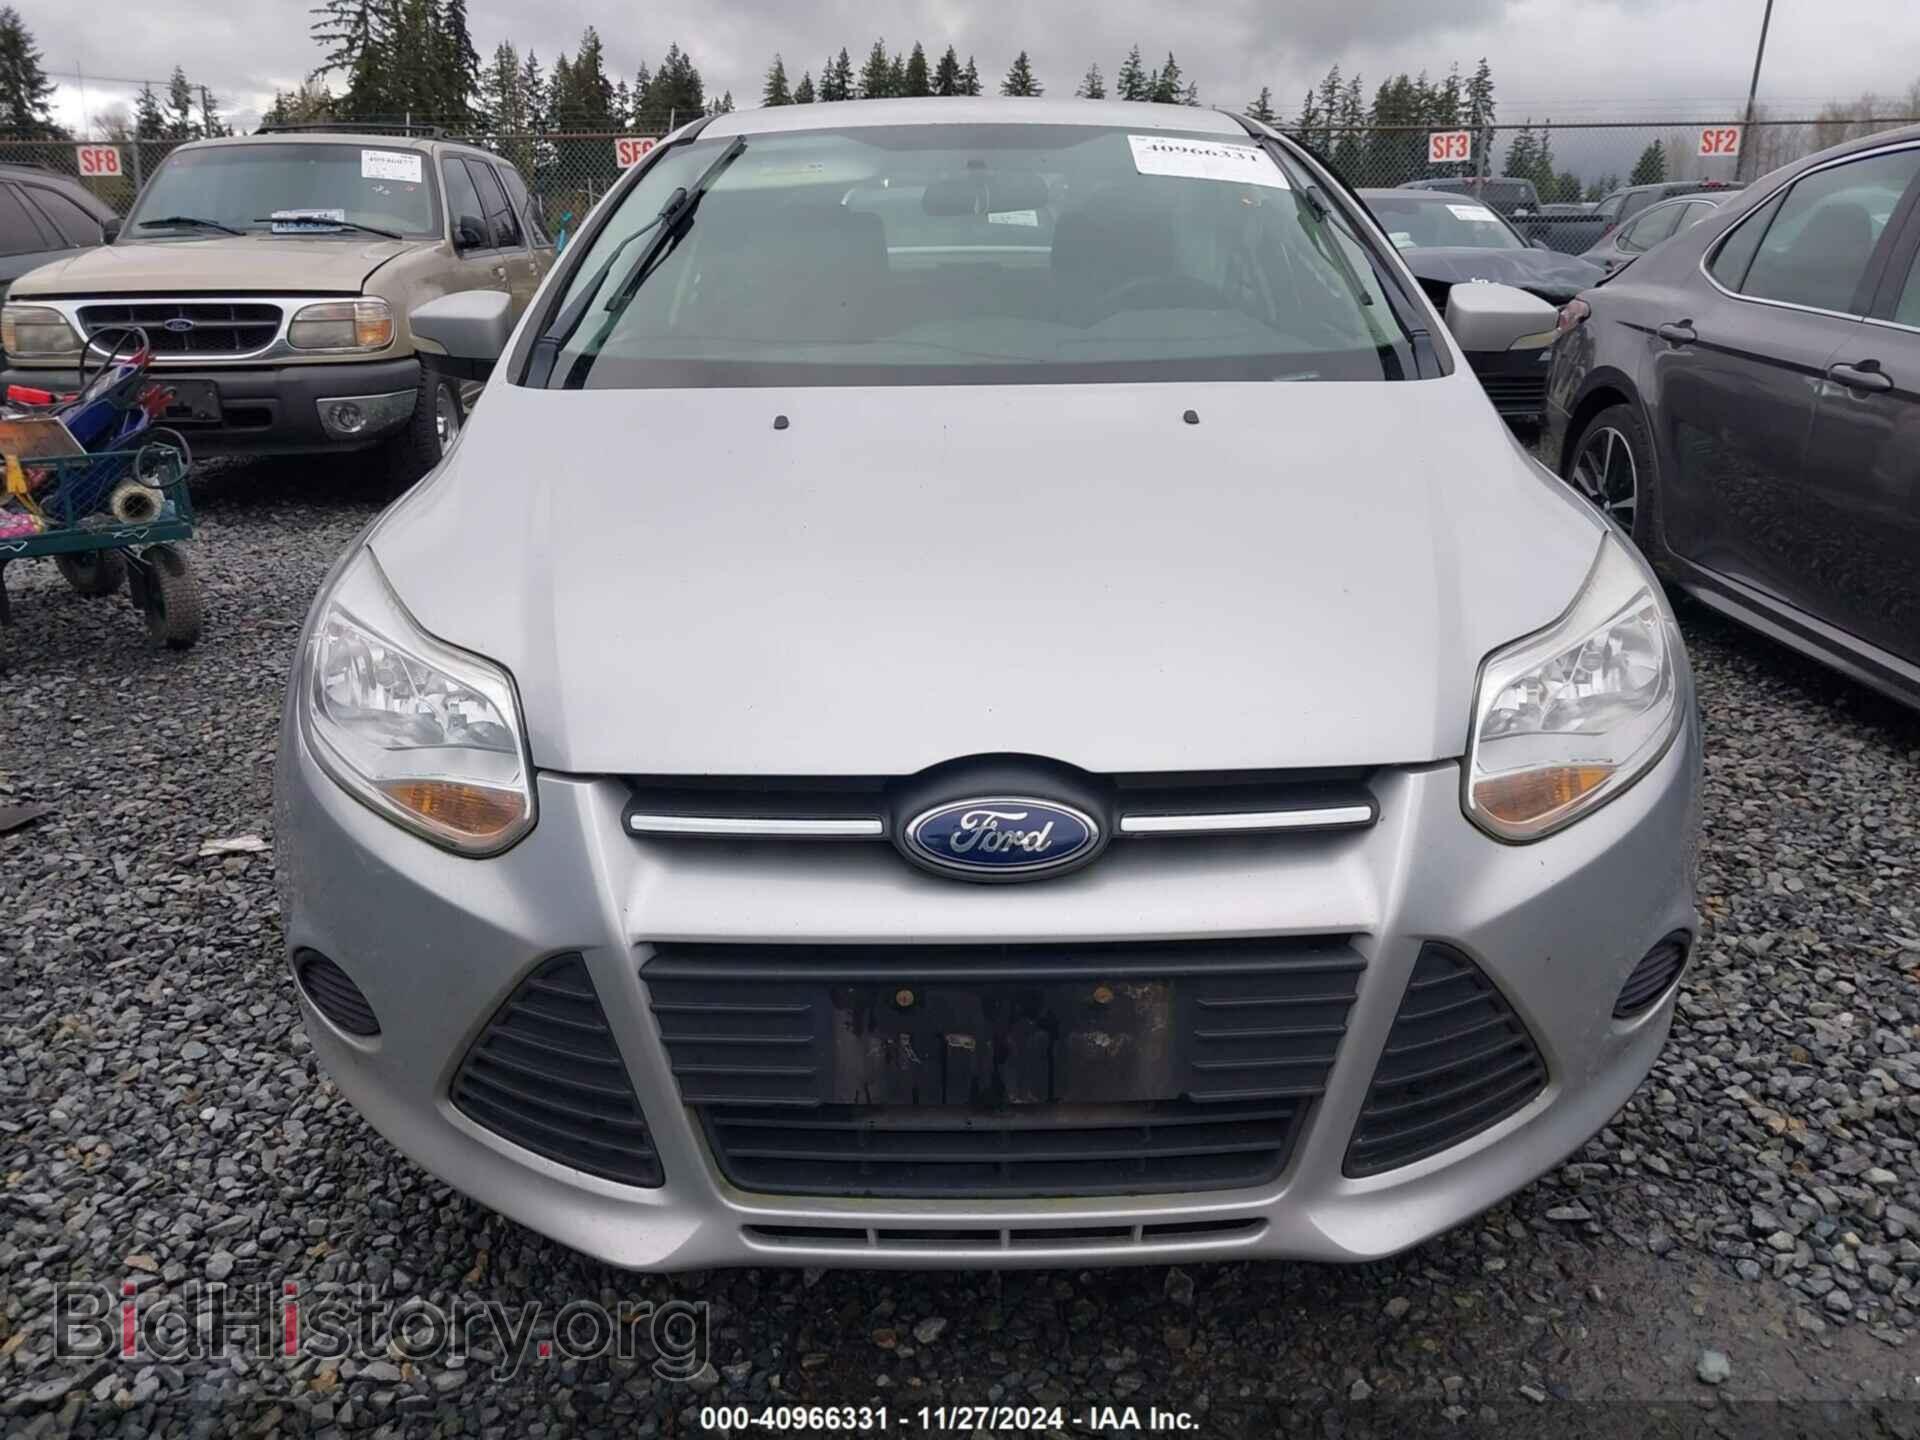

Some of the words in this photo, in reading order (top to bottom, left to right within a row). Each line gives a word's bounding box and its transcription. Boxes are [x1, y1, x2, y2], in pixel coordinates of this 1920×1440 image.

[1147, 144, 1257, 162] 40966331
[1432, 134, 1468, 159] SF3
[1701, 129, 1738, 154] SF2
[81, 149, 118, 172] SF8
[950, 810, 1055, 853] Ford
